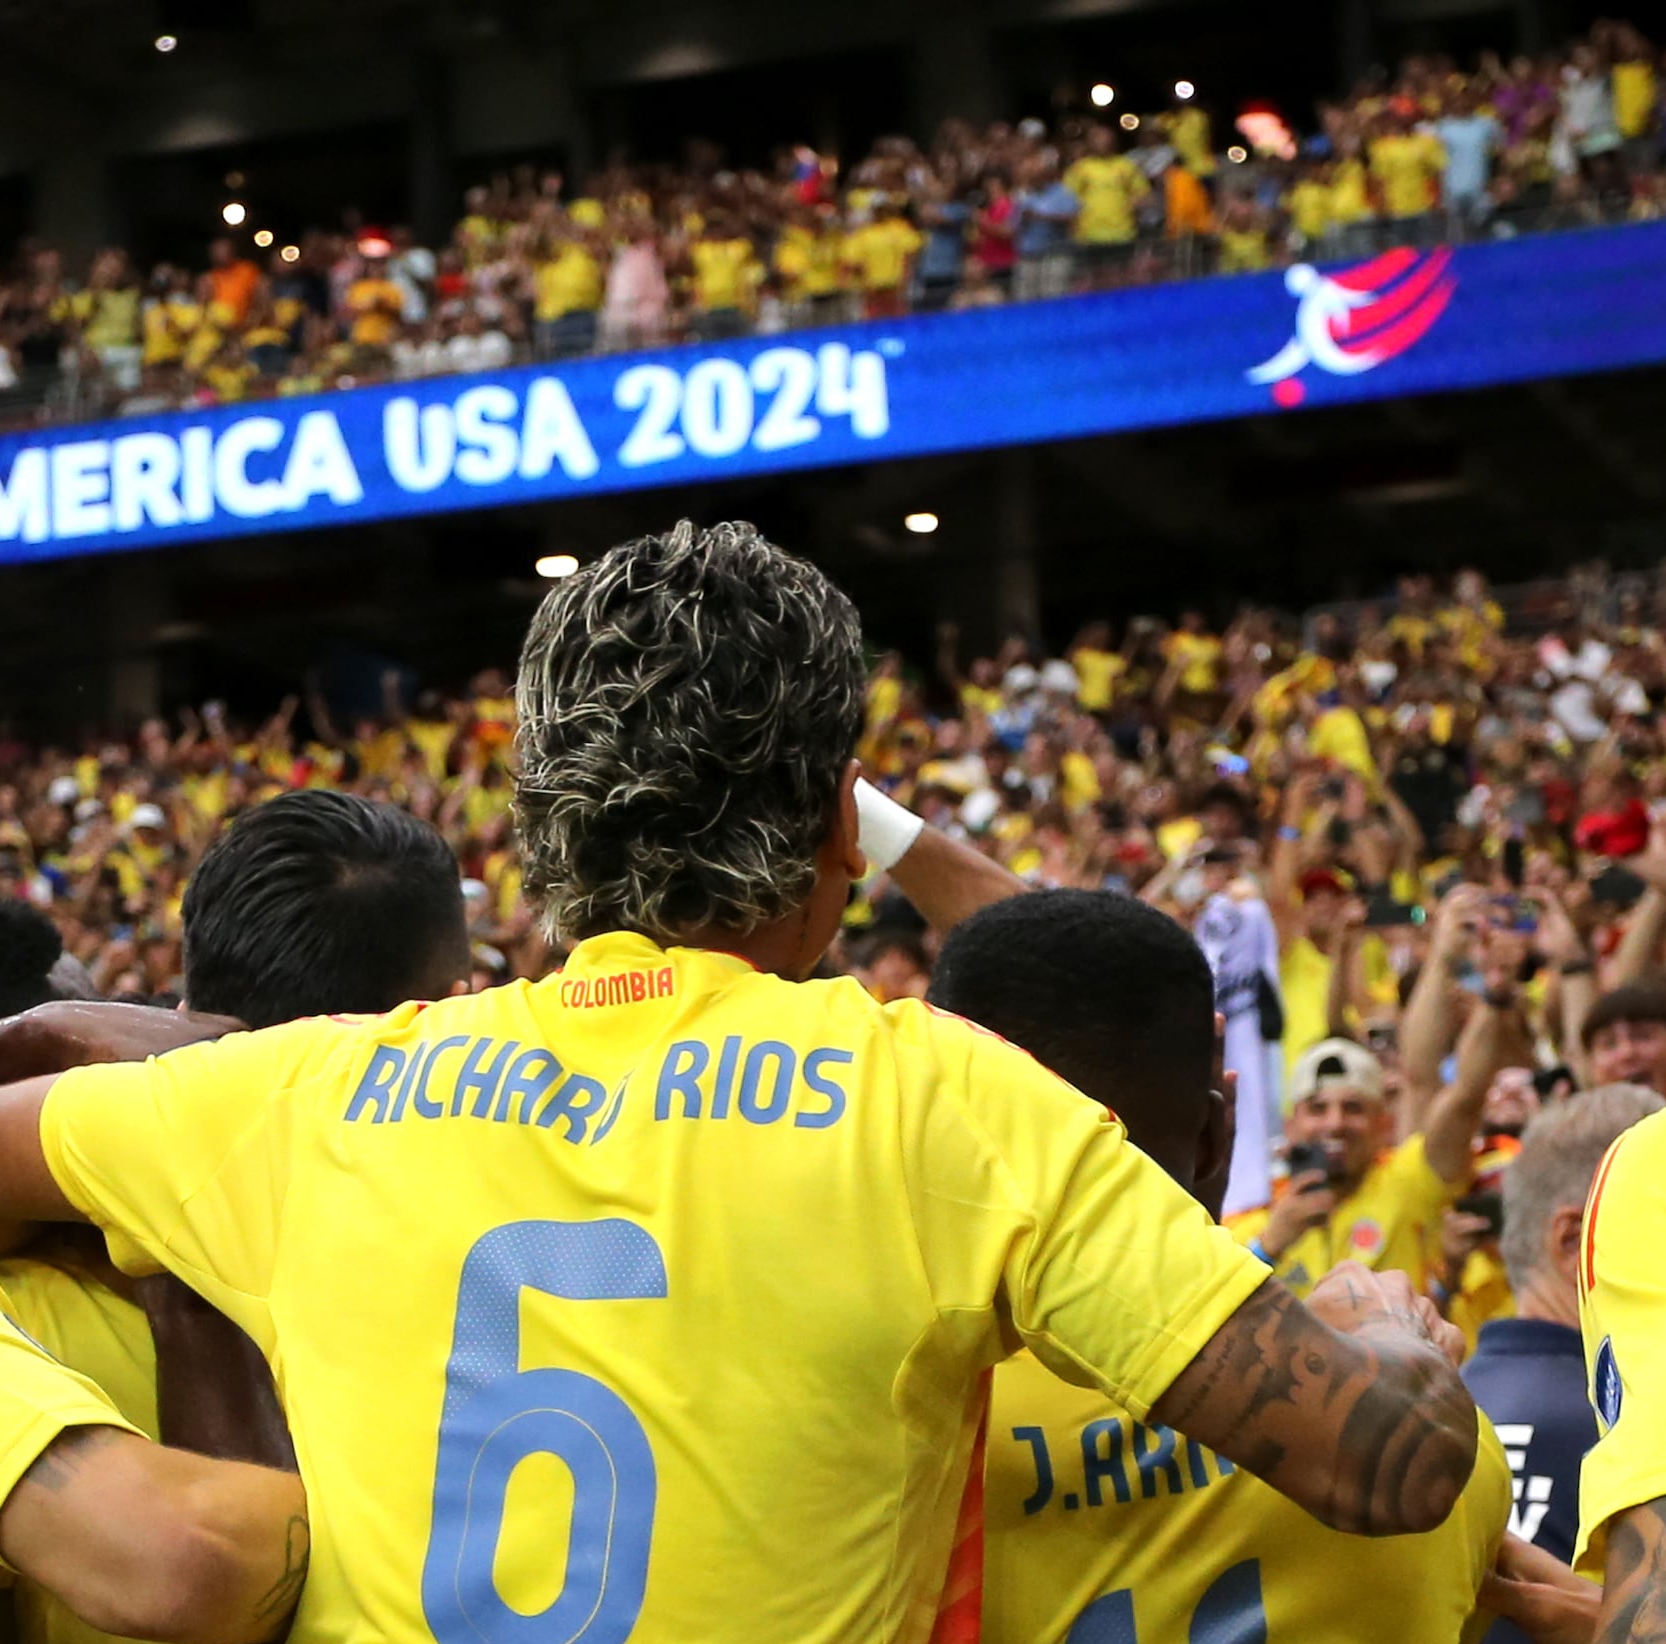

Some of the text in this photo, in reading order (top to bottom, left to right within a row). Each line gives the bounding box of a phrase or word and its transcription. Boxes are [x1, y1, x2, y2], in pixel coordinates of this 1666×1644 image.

[384, 377, 599, 493] USA
[612, 343, 890, 468] 2024
[560, 966, 675, 1009] COLOMBIA
[654, 1035, 854, 1129] RIOS
